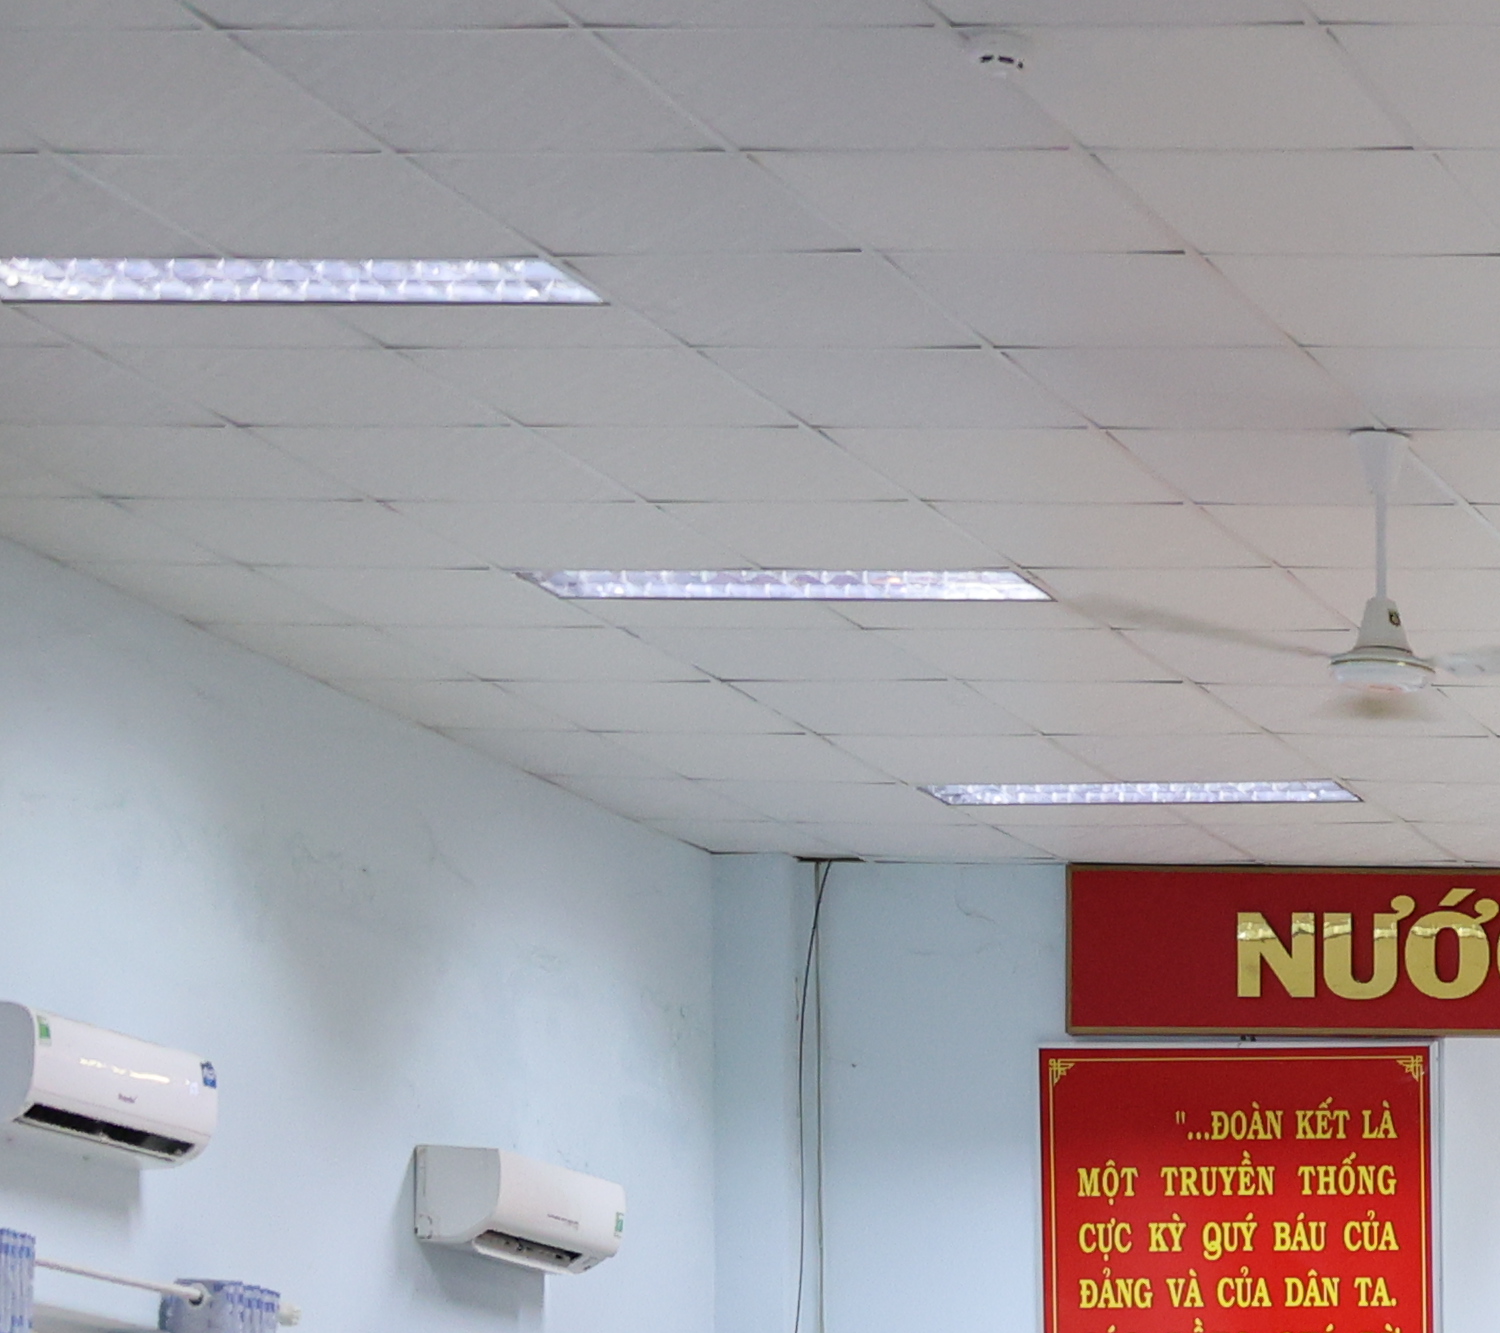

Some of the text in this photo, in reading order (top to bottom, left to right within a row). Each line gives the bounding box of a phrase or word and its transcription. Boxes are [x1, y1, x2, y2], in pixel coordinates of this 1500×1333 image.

[1296, 1097, 1349, 1139] KẾT
[1362, 1101, 1397, 1138] LÀ
[1078, 1151, 1396, 1205] MỘT TRUYỀN THỐNG
[1079, 1210, 1399, 1261] CỰC KỲ QUÝ BÁU CỦA
[1080, 1267, 1396, 1308] ĐẢNG VÀ CỦA DÂN TA.
